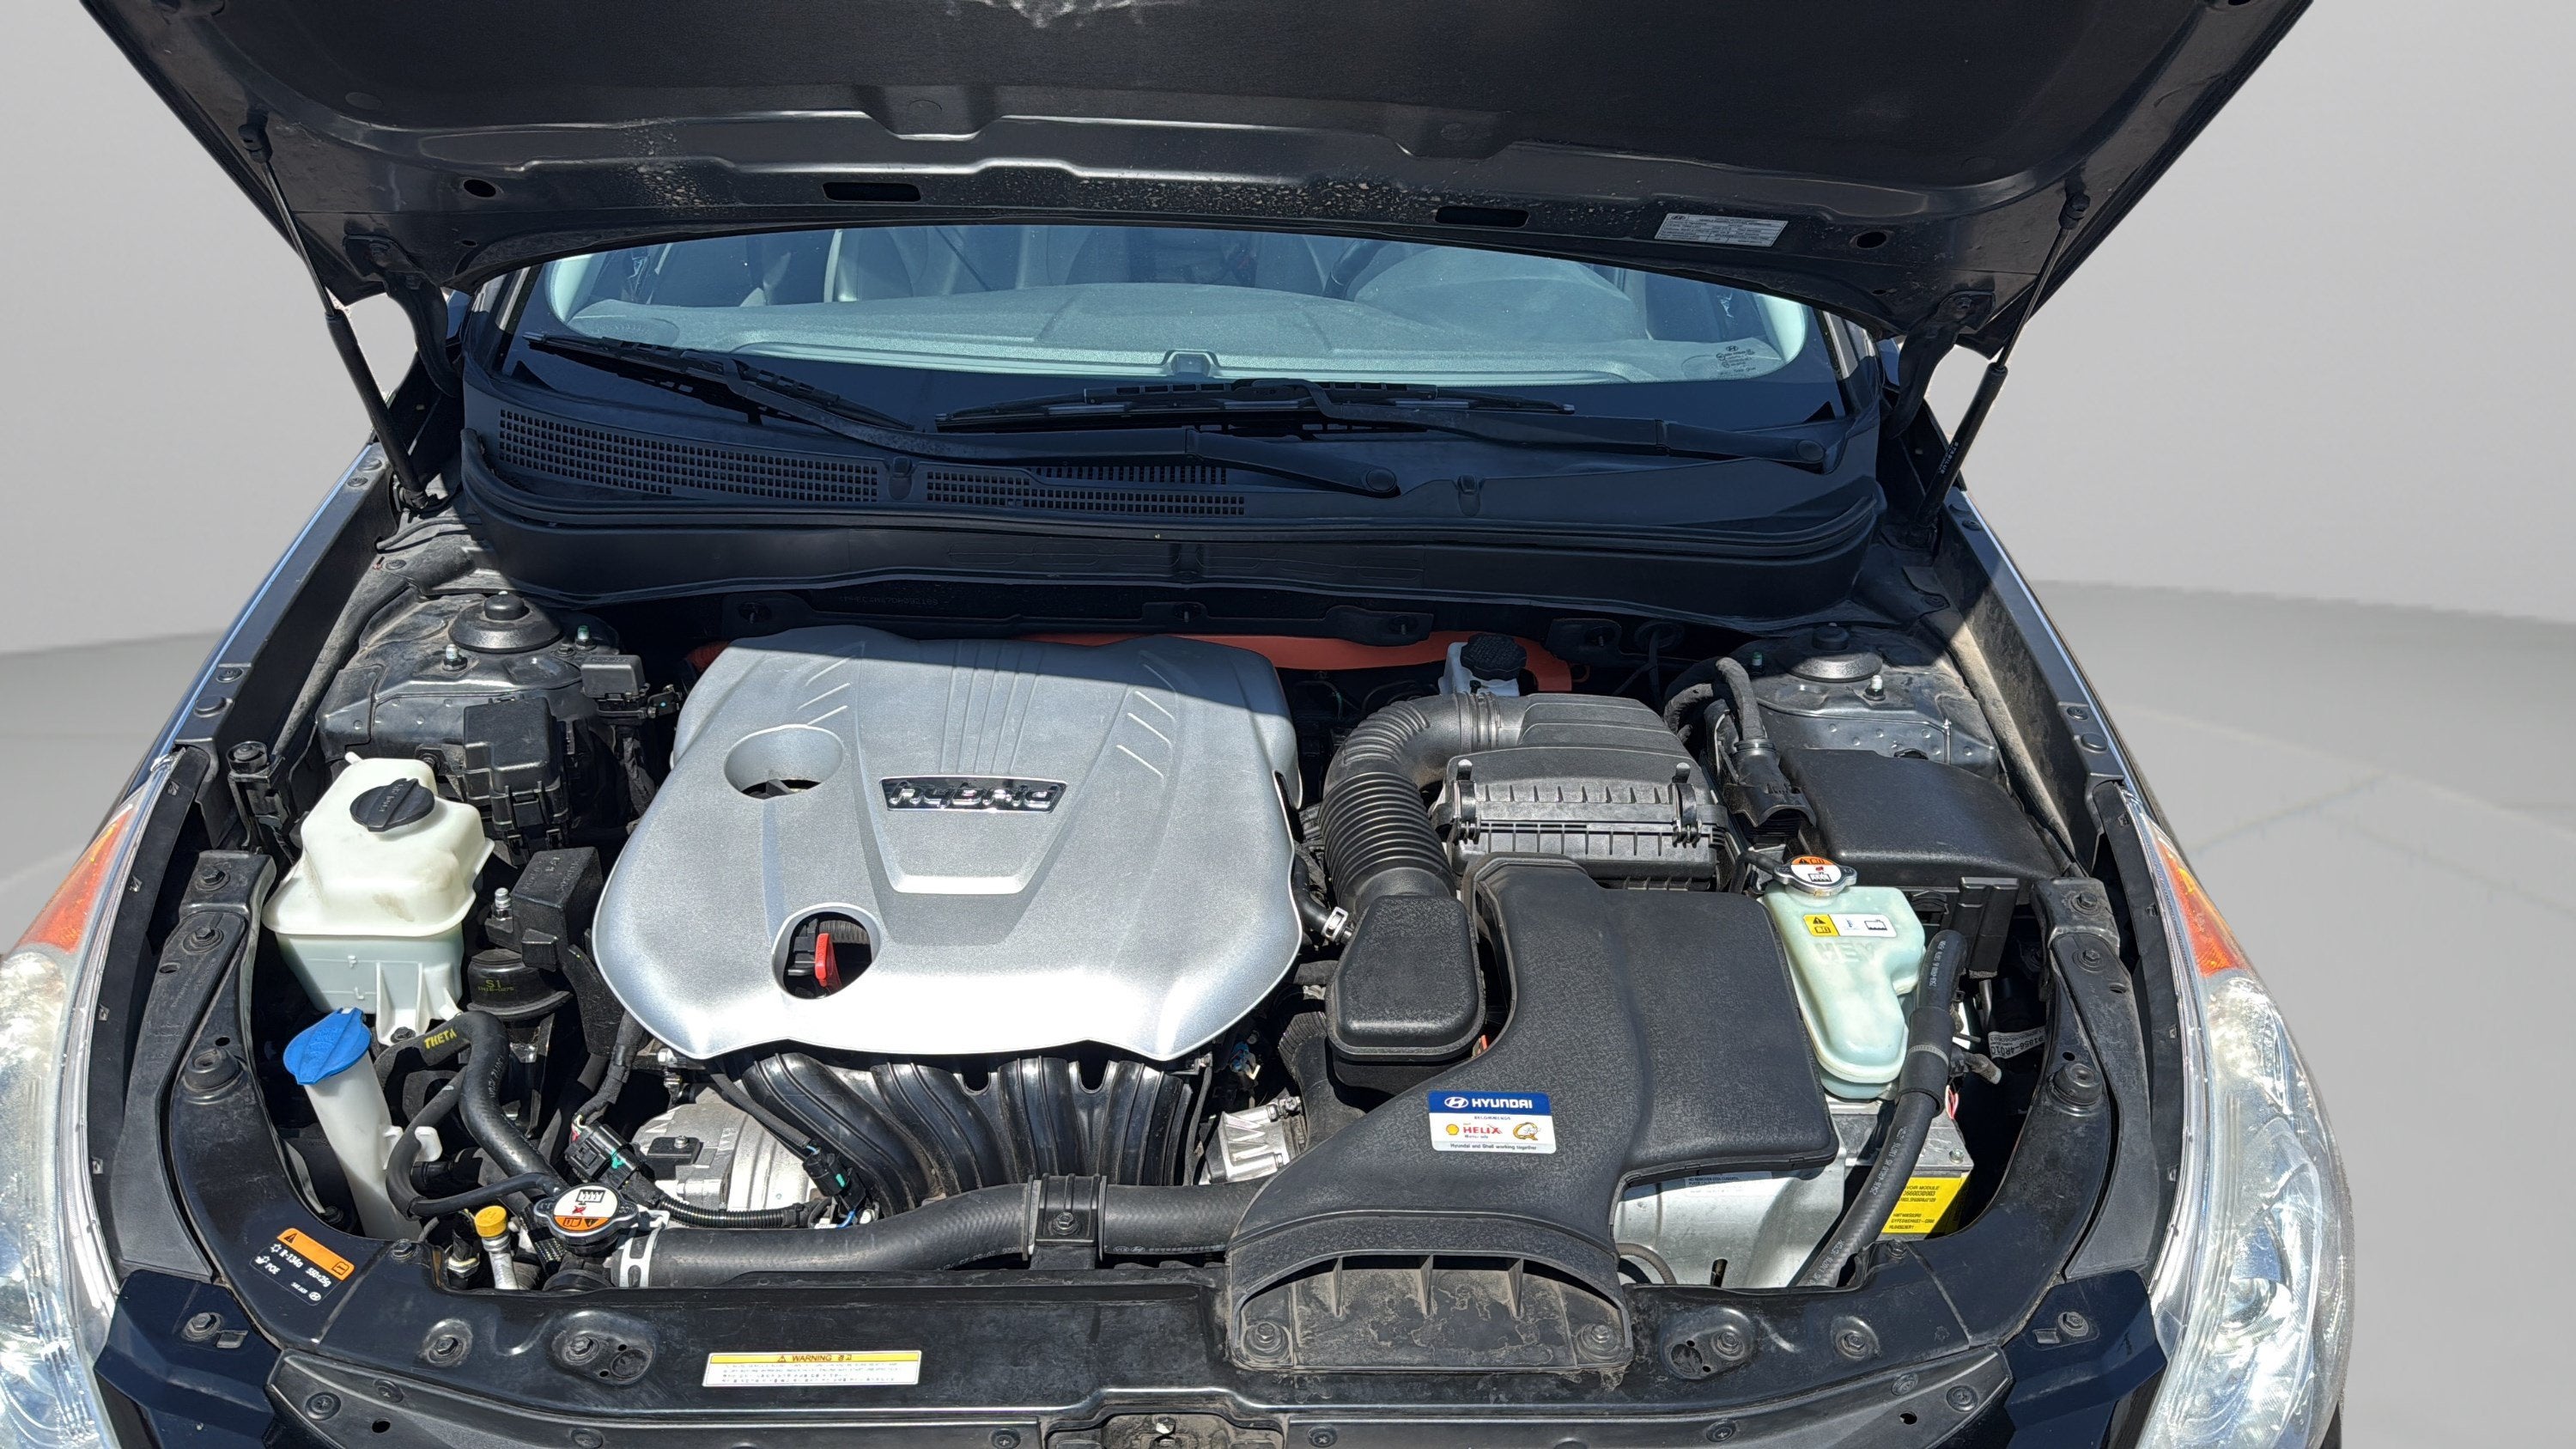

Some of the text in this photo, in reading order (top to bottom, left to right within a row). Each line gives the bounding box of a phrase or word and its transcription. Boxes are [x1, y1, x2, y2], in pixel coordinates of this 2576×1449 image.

[889, 781, 1061, 810] hybrid
[423, 1028, 458, 1050] THETA
[1472, 1099, 1534, 1109] HYUNDAI
[1463, 1125, 1502, 1135] HELIX
[278, 1249, 304, 1269] R-134a
[264, 1263, 281, 1275] POE
